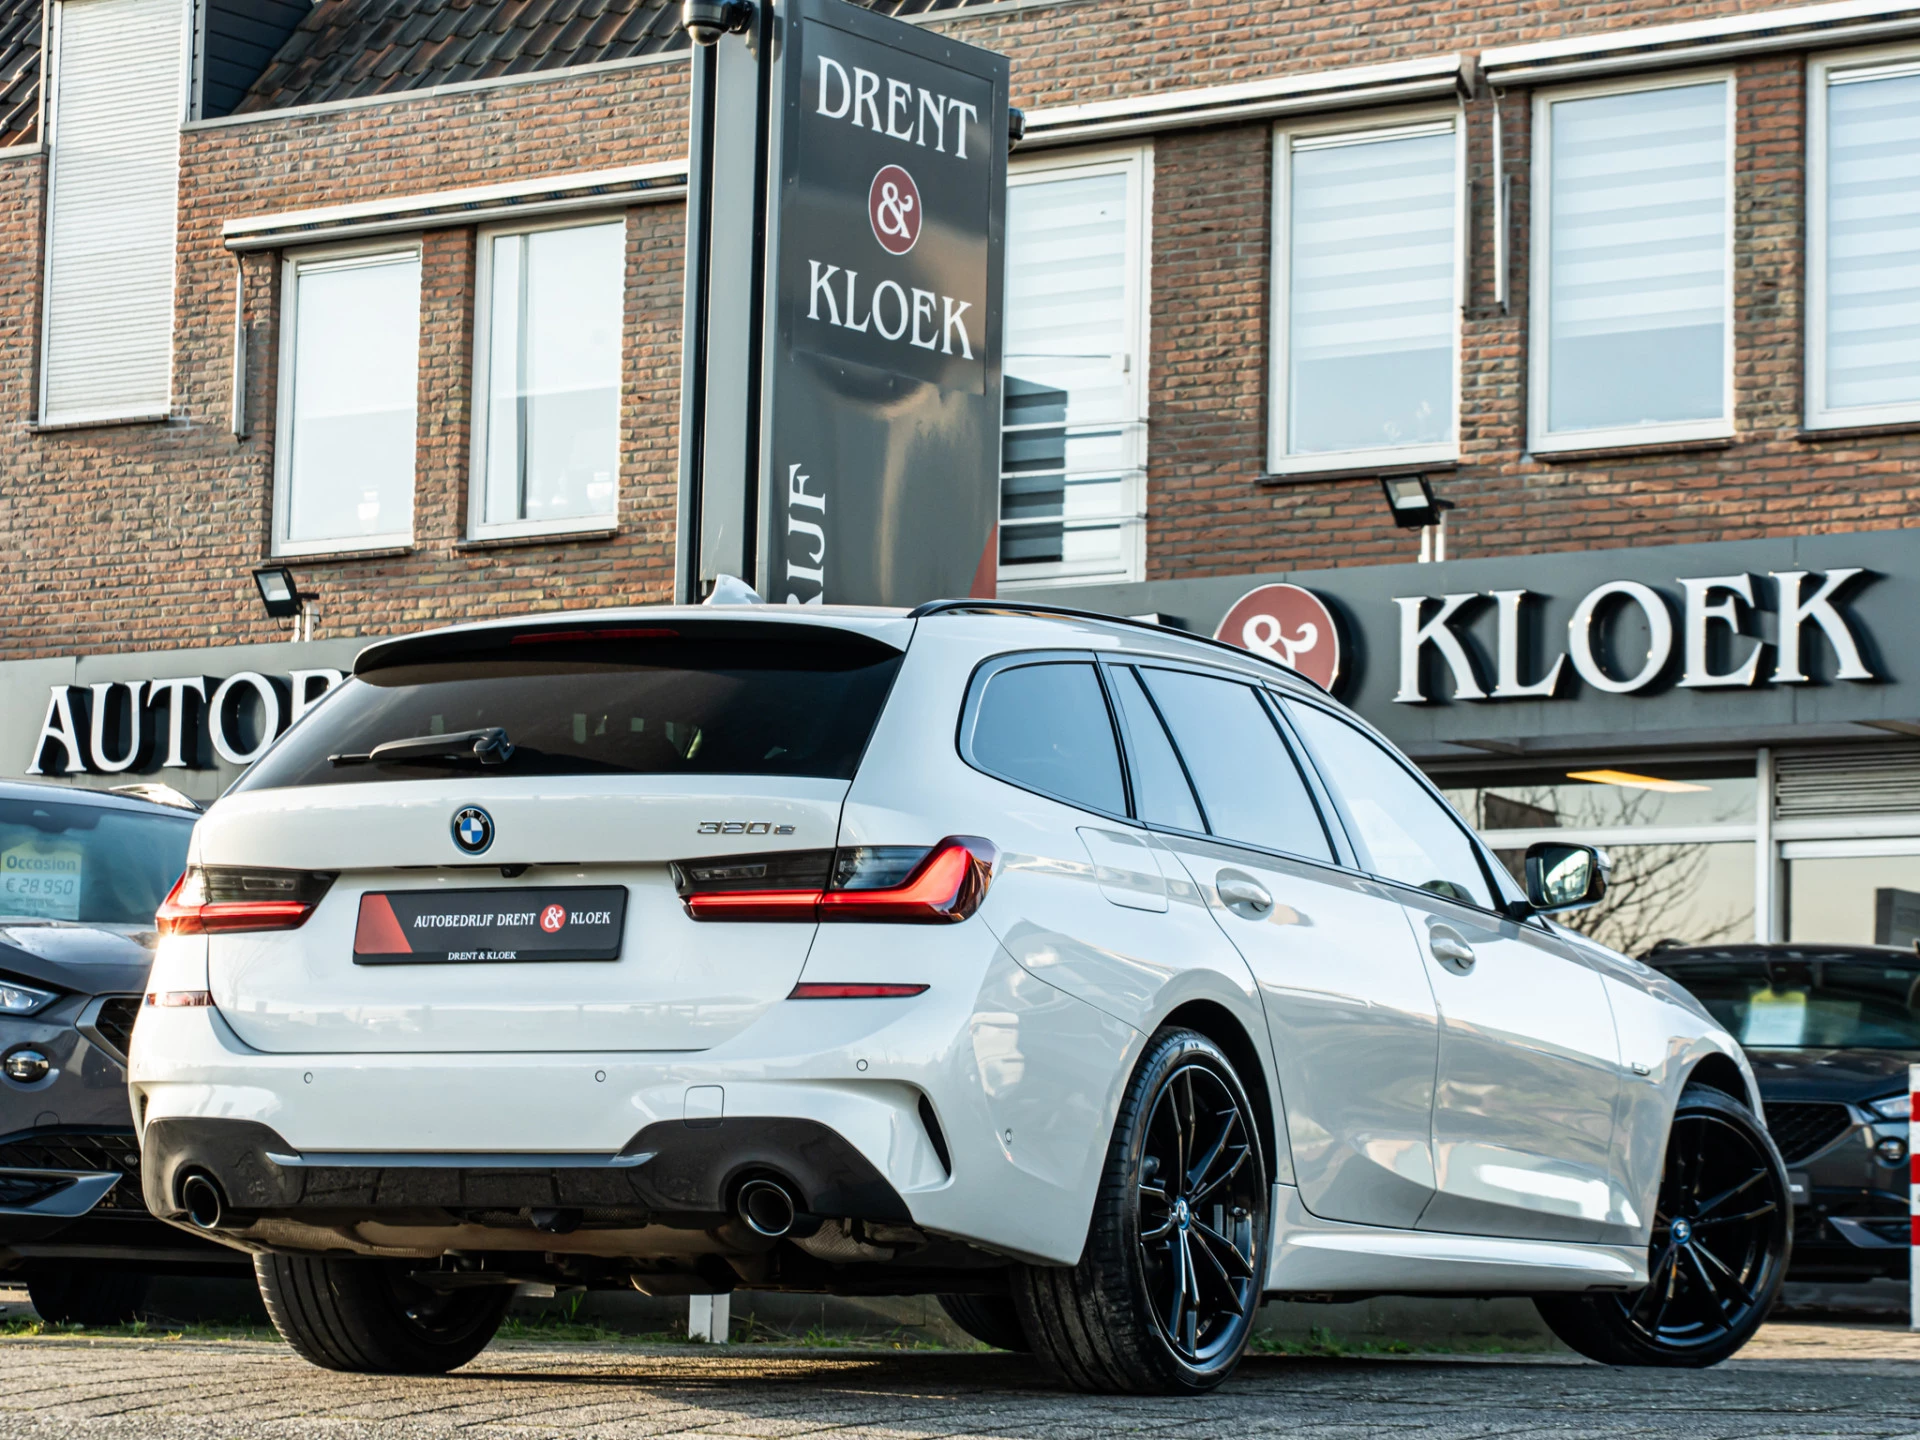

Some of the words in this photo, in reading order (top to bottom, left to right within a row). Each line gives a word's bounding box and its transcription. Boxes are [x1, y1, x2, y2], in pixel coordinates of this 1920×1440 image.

[816, 55, 978, 160] DRENT
[877, 181, 913, 239] &
[807, 259, 974, 361] KLOEK
[1393, 568, 1874, 703] KLOEK
[697, 821, 797, 836] 320e
[6, 855, 76, 871] Occasion
[414, 914, 493, 928] AUTOBEDRIJF
[497, 913, 536, 926] DRENT
[544, 906, 563, 929] &
[570, 911, 611, 924] KLOEK
[448, 951, 477, 960] DRENT
[479, 951, 486, 960] &
[487, 951, 516, 960] KLOEK
